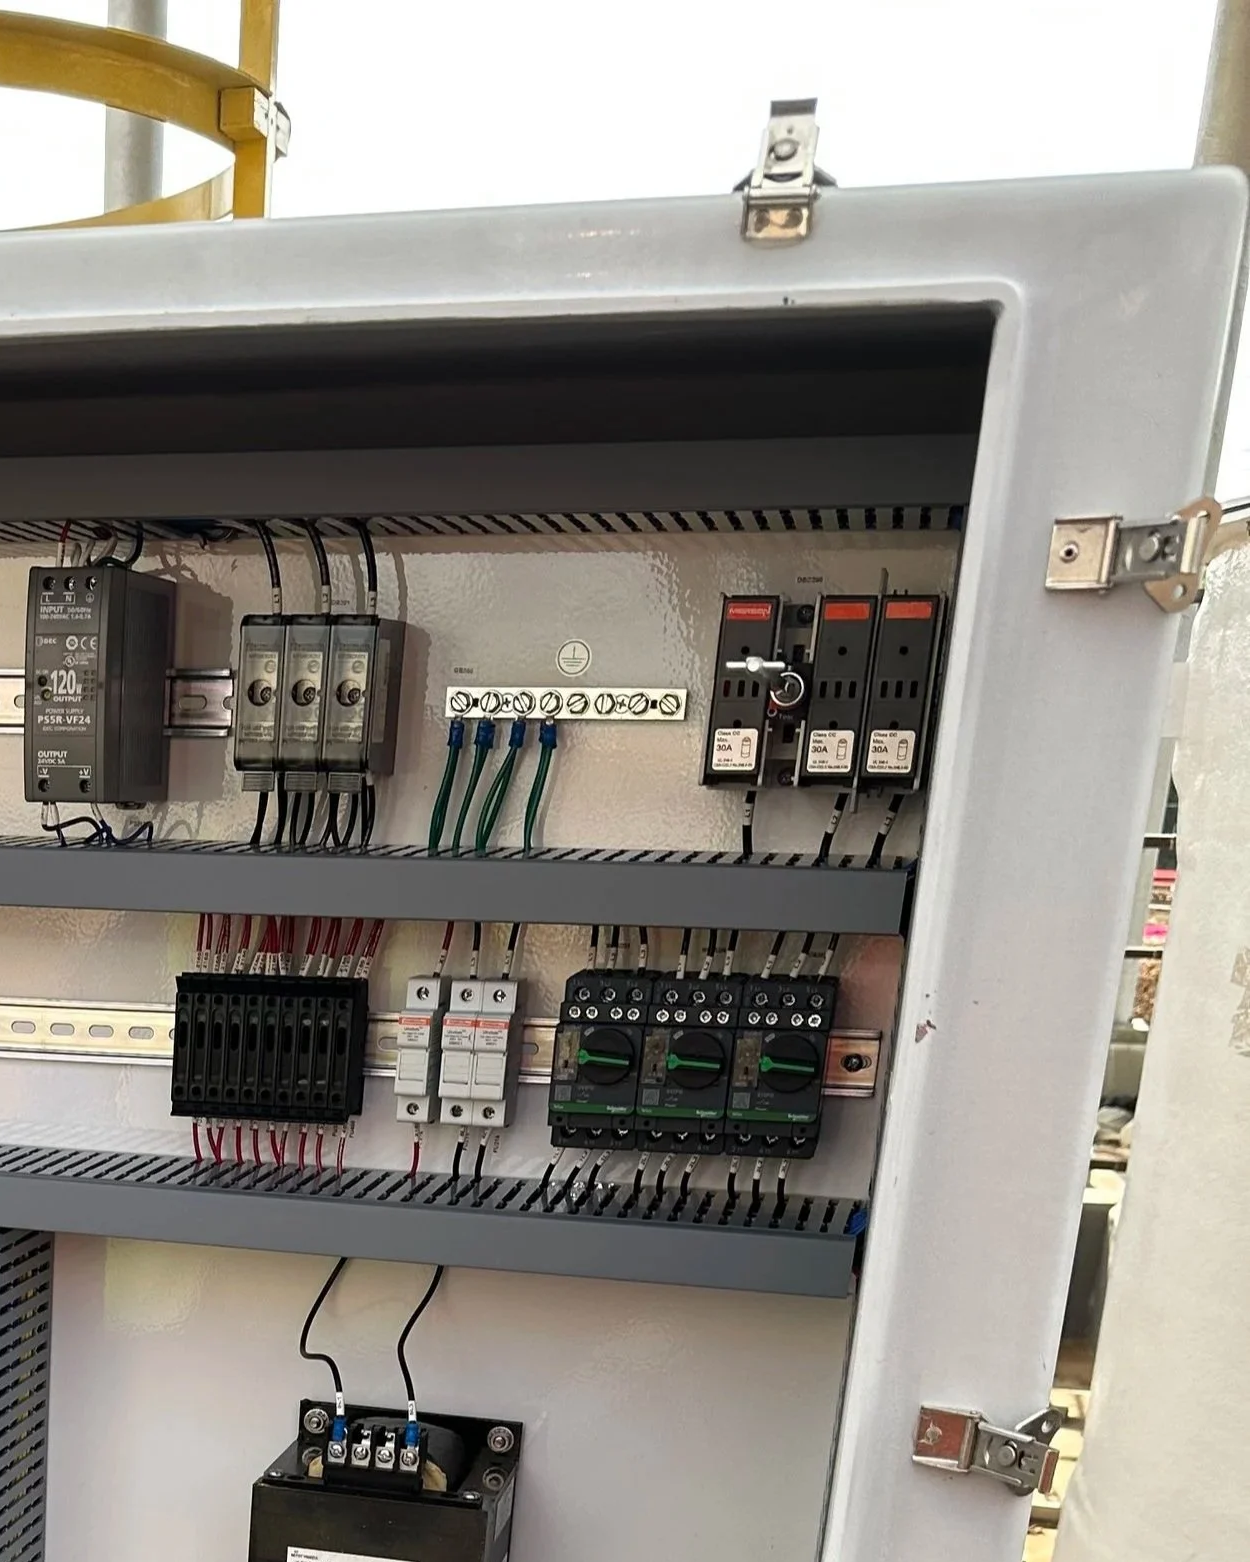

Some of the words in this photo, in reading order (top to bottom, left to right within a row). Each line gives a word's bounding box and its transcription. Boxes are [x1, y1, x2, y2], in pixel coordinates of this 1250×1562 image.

[40, 605, 65, 613] INPUT
[53, 694, 82, 702] OUTPUT
[37, 750, 68, 758] OUTPUT
